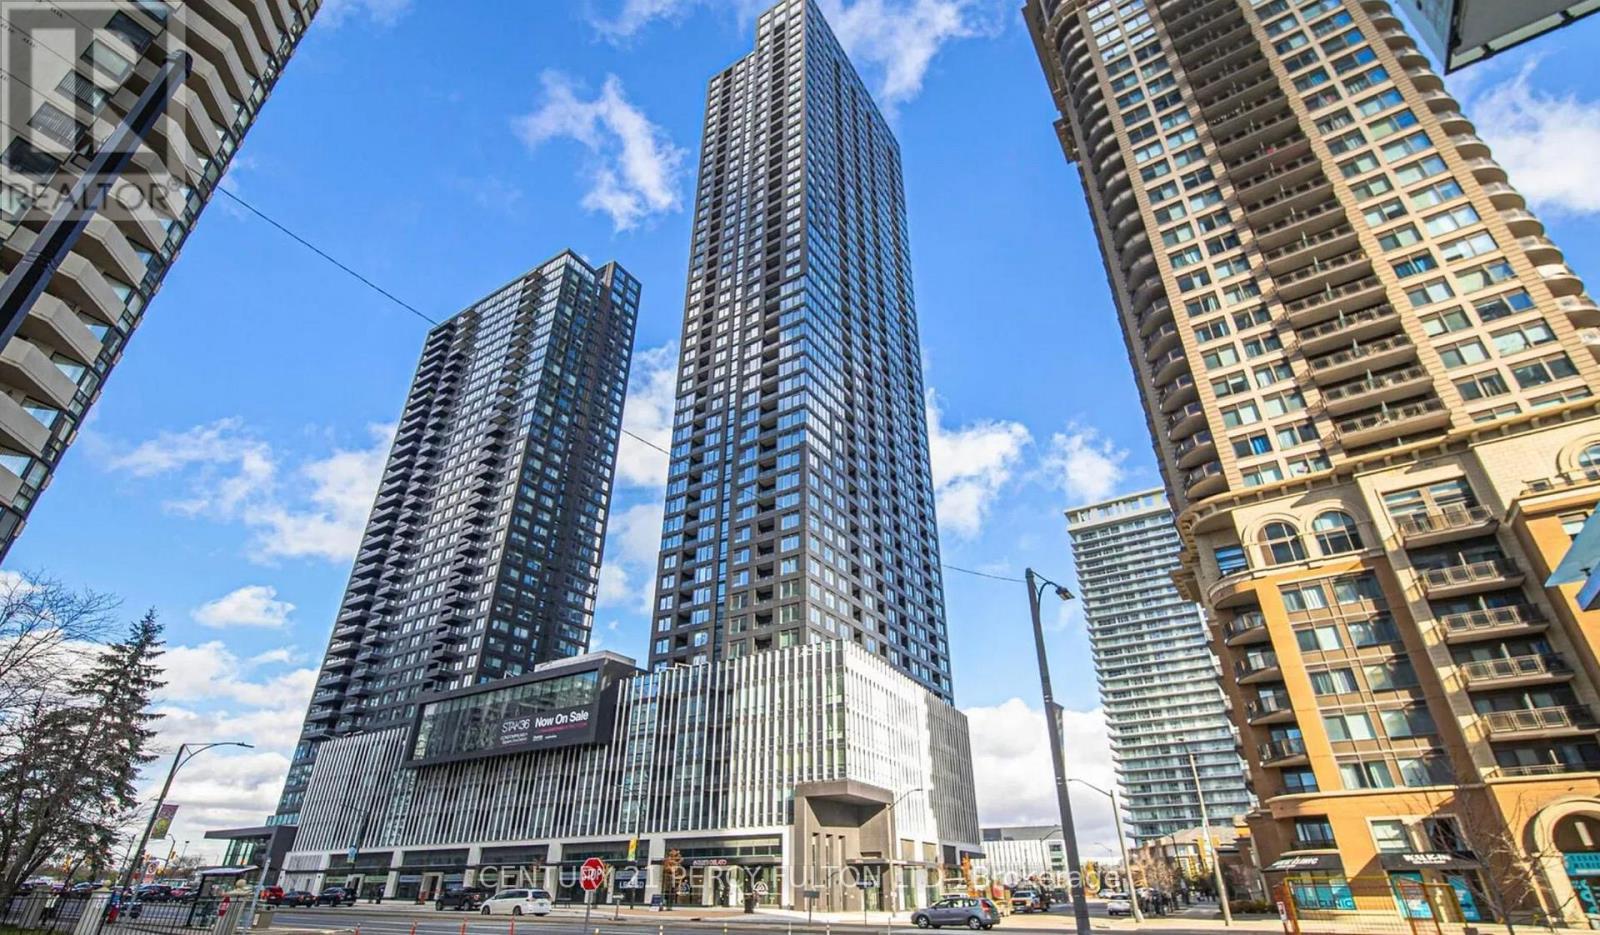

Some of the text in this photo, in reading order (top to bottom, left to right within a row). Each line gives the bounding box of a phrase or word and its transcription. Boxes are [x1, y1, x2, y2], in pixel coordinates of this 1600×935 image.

[535, 709, 589, 728] Now On Sale
[582, 868, 603, 880] STOP
